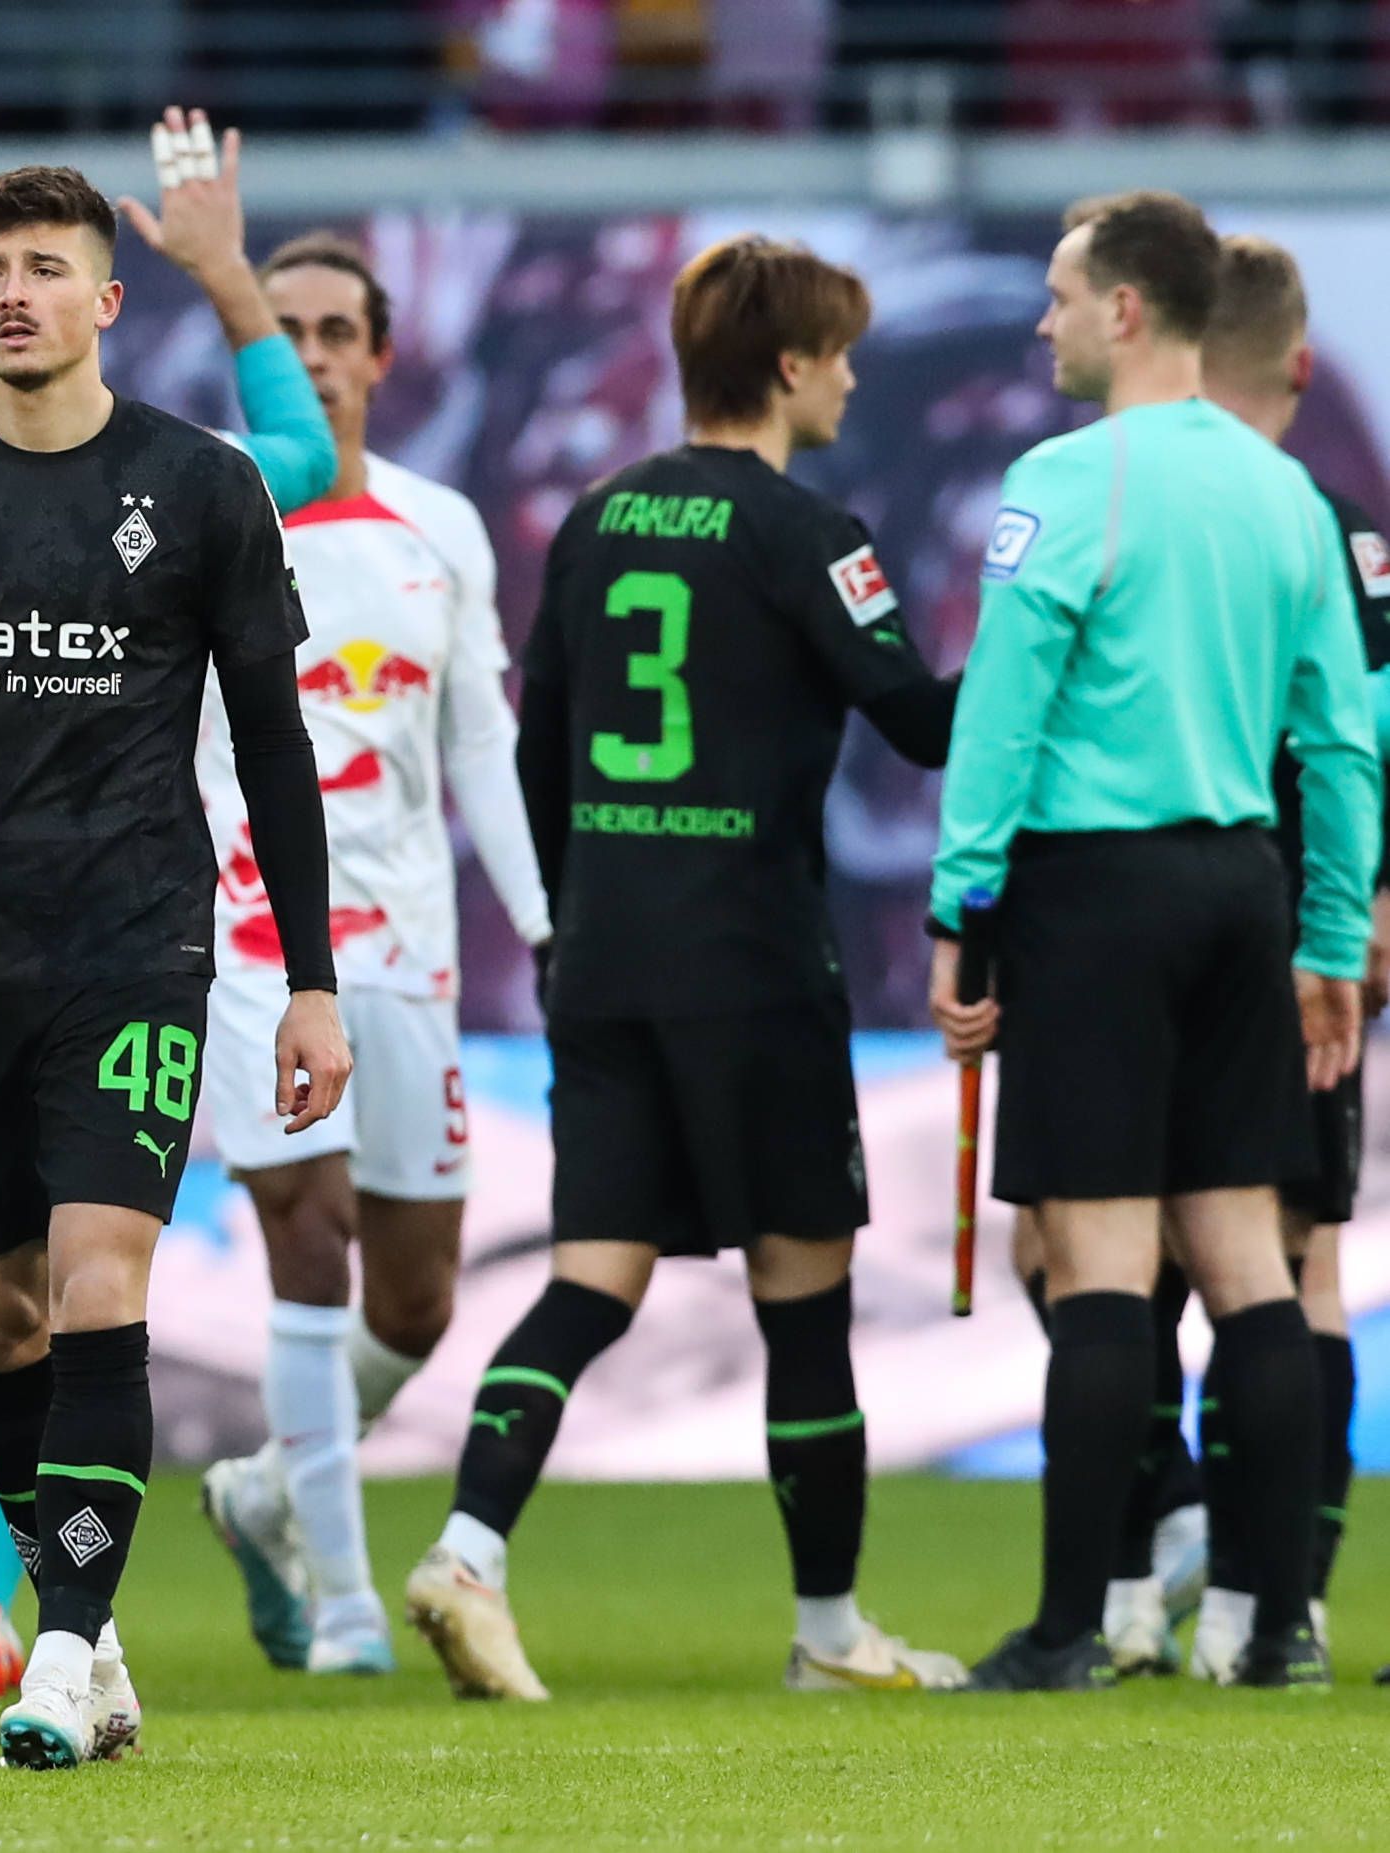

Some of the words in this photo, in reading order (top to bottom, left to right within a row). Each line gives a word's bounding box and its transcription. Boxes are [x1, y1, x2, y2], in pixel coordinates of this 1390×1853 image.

[597, 492, 733, 543] ITAKURA
[6, 670, 27, 693] in
[34, 672, 122, 698] yourself
[590, 570, 695, 782] 3
[98, 1021, 198, 1122] 48
